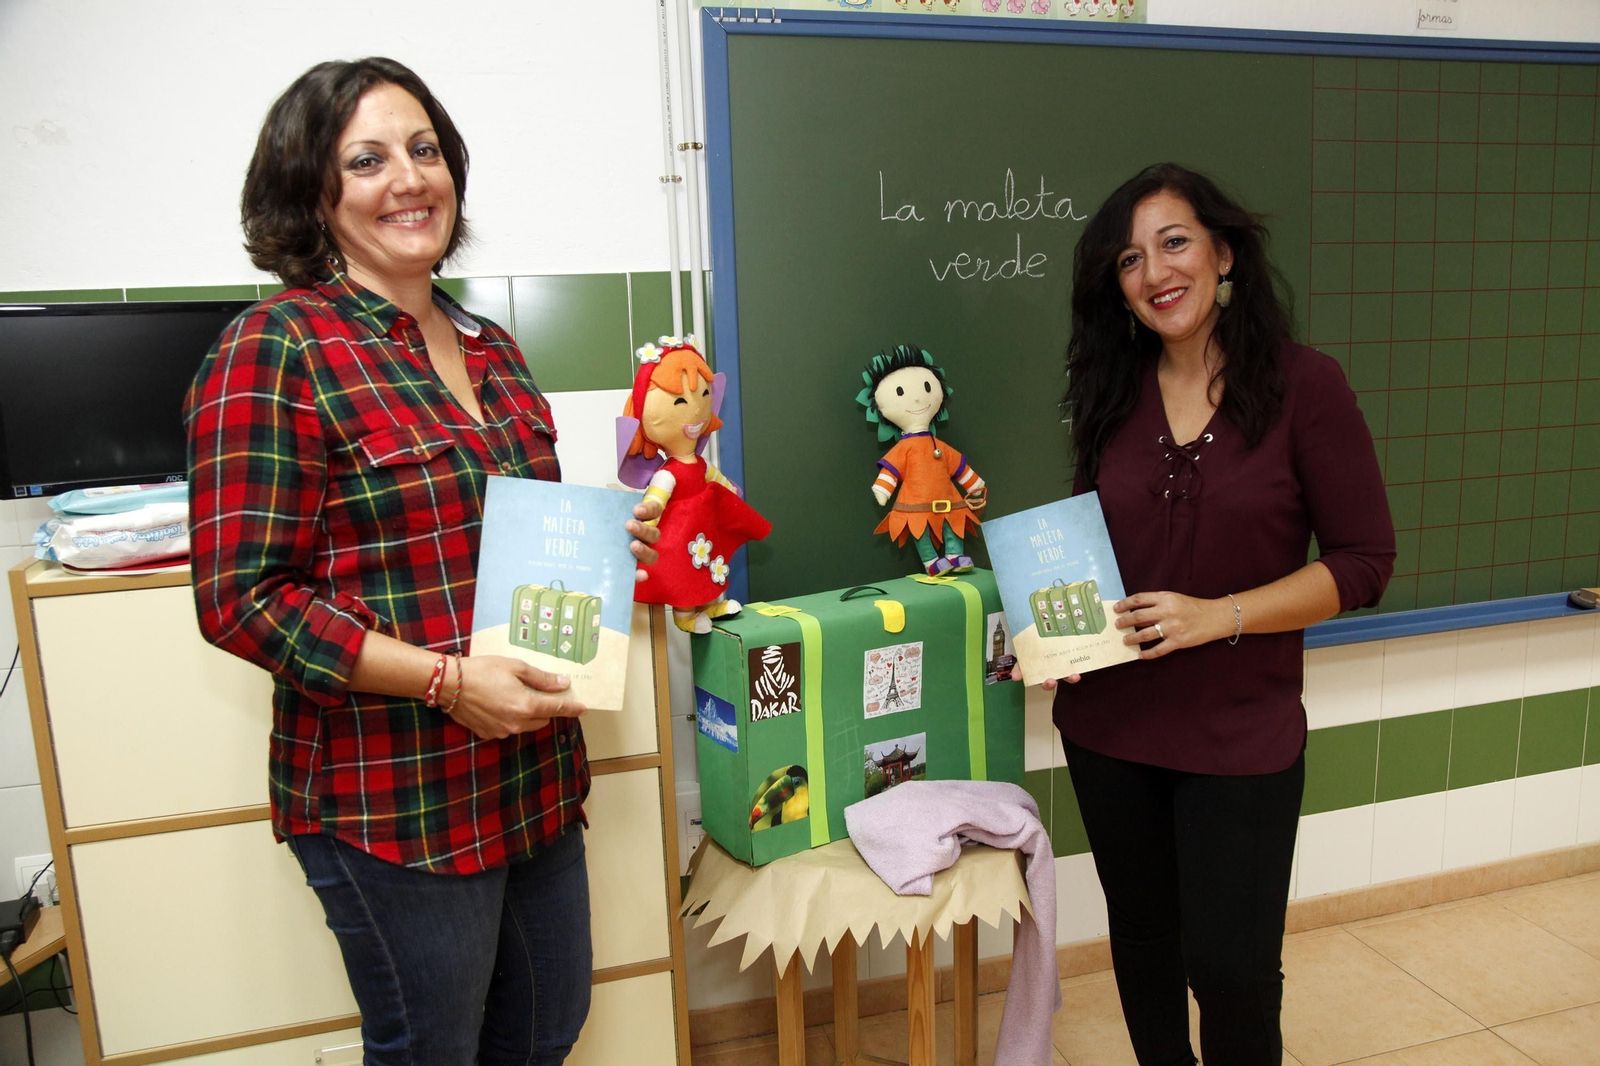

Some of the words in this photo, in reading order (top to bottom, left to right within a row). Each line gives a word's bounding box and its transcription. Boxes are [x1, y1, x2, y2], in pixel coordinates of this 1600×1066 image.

[1417, 9, 1452, 28] formas
[879, 170, 925, 222] La
[944, 168, 1088, 223] maleta
[929, 233, 1047, 282] verde
[560, 498, 572, 514] LA
[542, 515, 586, 536] MALETA
[1036, 518, 1049, 530] LA
[544, 537, 580, 559] VERDE
[1029, 528, 1064, 549] MALETA
[1036, 545, 1066, 565] VERDE
[750, 691, 802, 722] DAKAR
